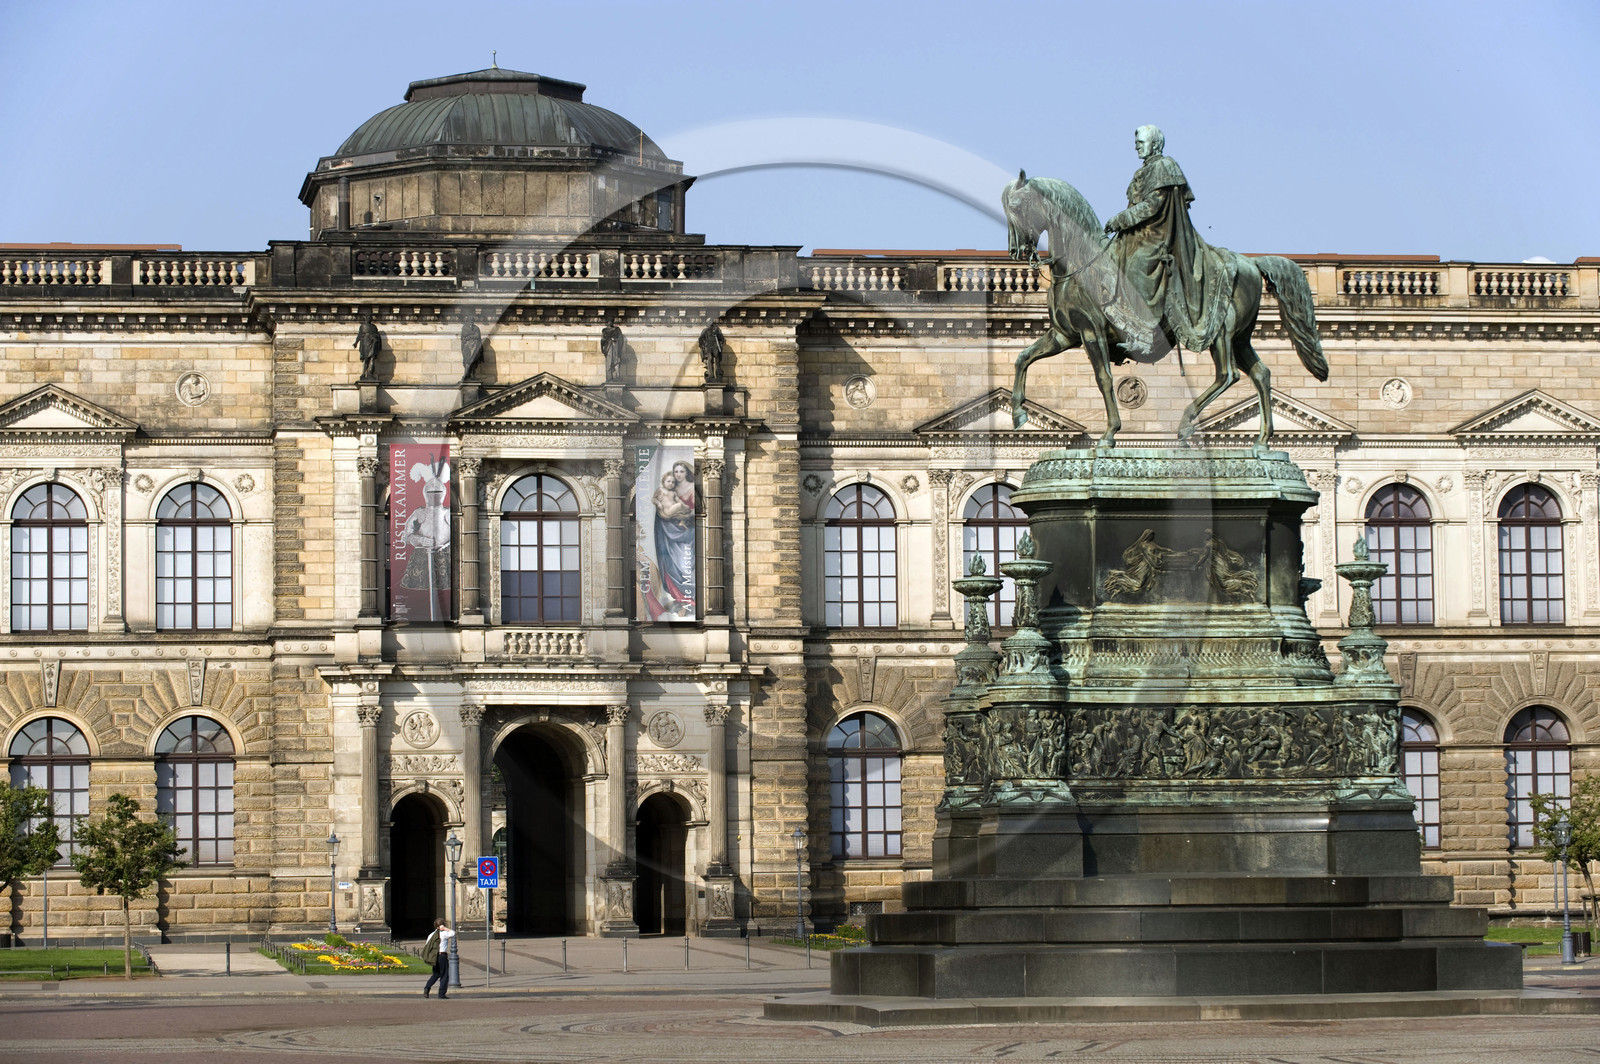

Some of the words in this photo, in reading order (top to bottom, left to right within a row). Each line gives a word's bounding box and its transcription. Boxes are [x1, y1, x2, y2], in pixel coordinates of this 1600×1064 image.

[393, 448, 407, 561] RÜSTKAMMER
[682, 545, 692, 586] Meister
[681, 589, 692, 612] Alte
[479, 878, 497, 887] TAXI
